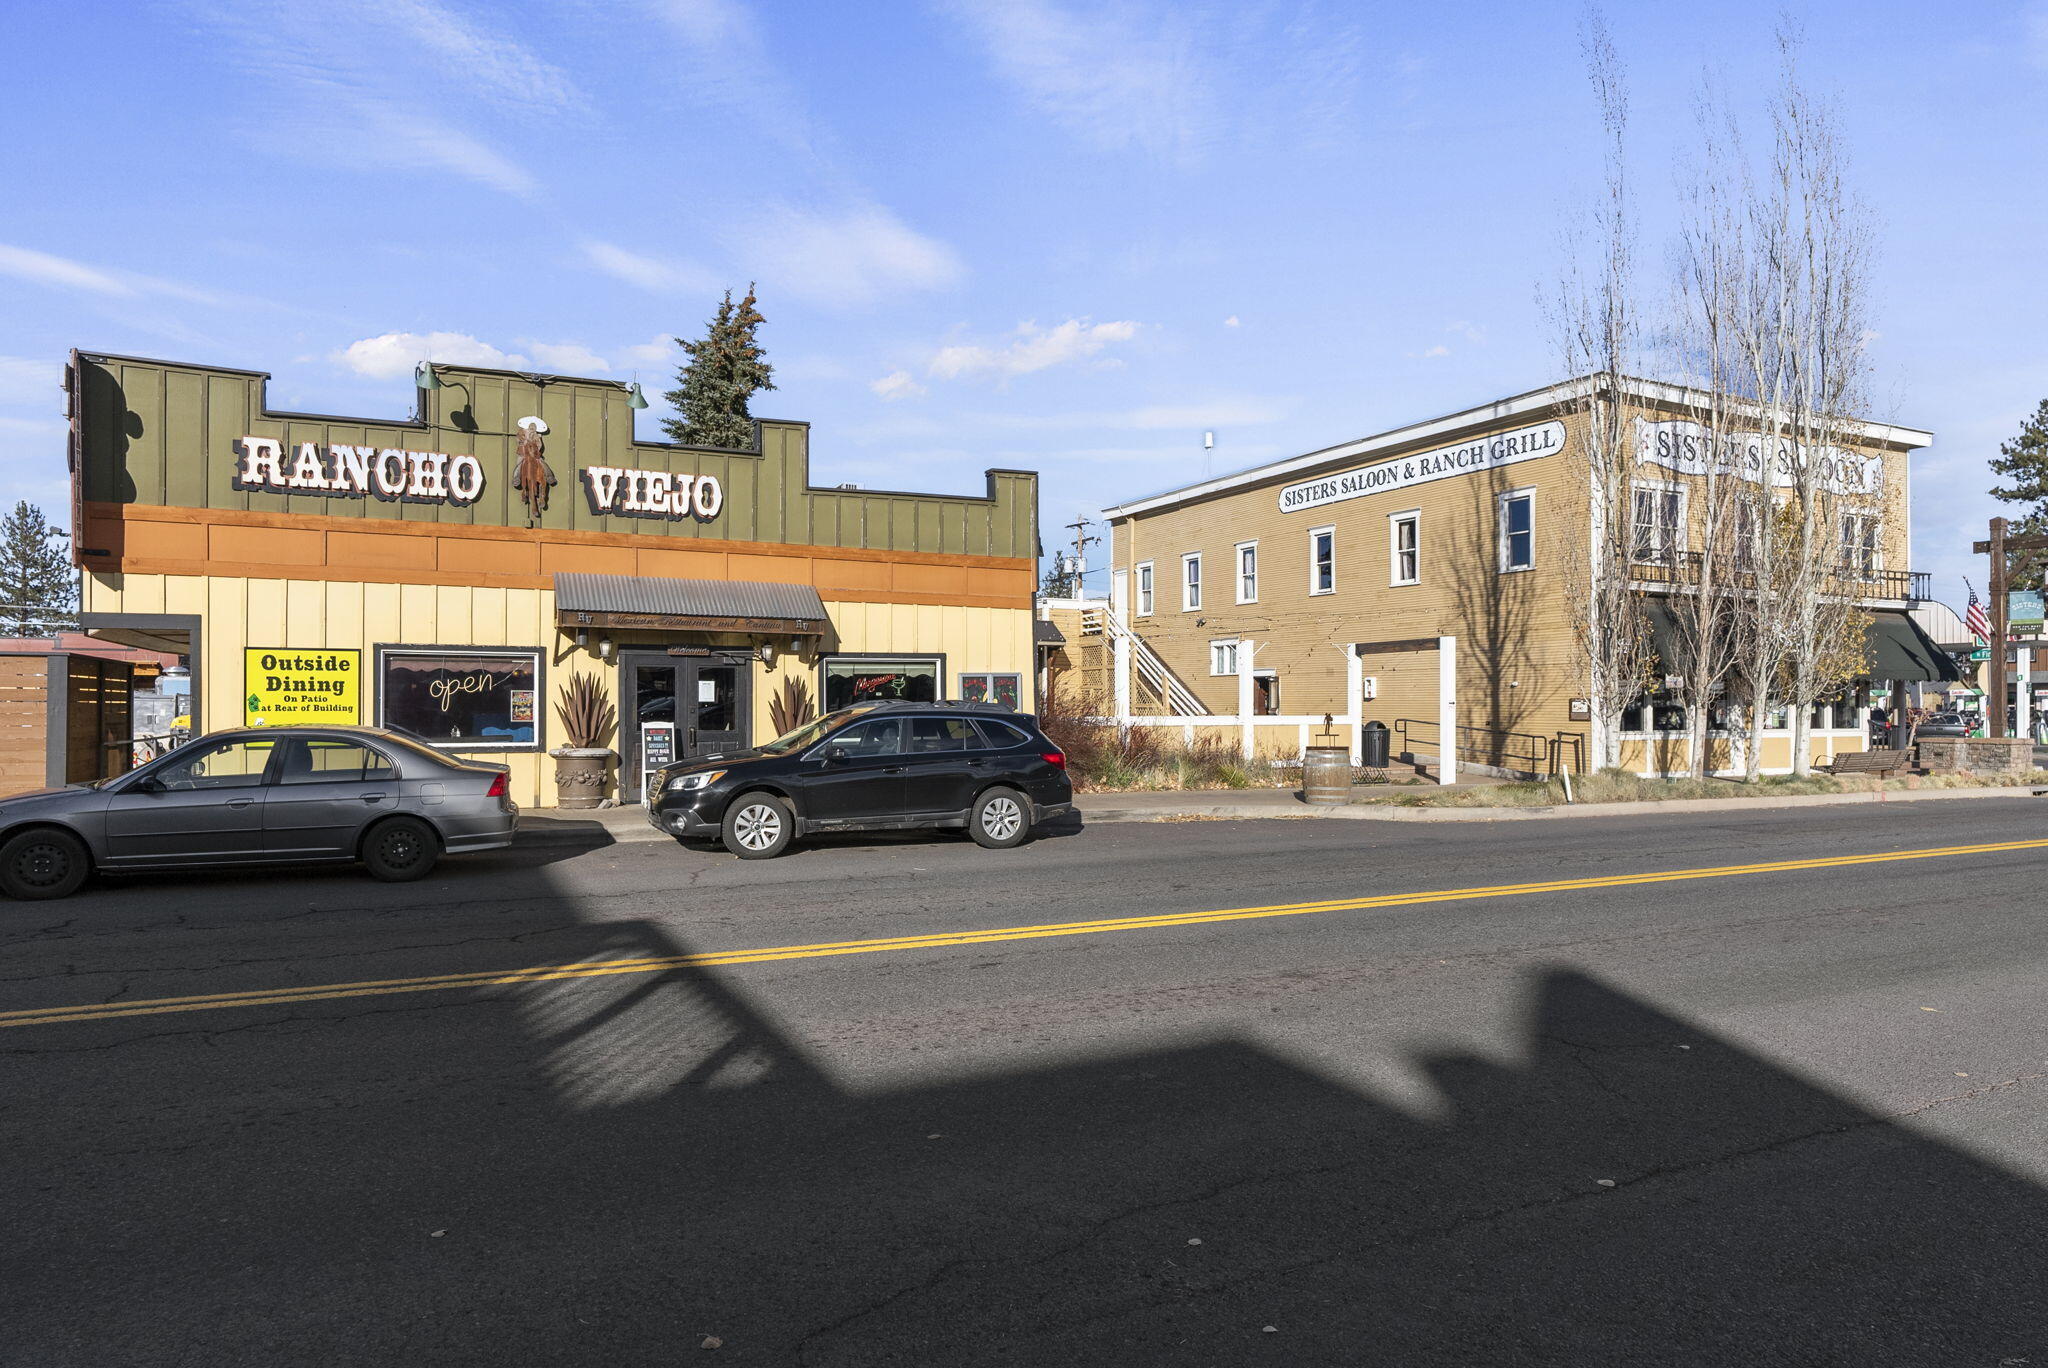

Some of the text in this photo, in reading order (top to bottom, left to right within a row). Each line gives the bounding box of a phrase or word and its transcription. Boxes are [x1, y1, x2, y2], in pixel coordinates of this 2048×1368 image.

[240, 435, 724, 519] RANCHO VIEJO
[1284, 429, 1558, 507] SISTERS SALOON & RANCH GRILL
[1778, 448, 1865, 490] SOON
[261, 654, 350, 672] Outside
[266, 676, 345, 696] Dining
[430, 673, 492, 712] open
[301, 704, 311, 712] of
[314, 704, 354, 714] Building
